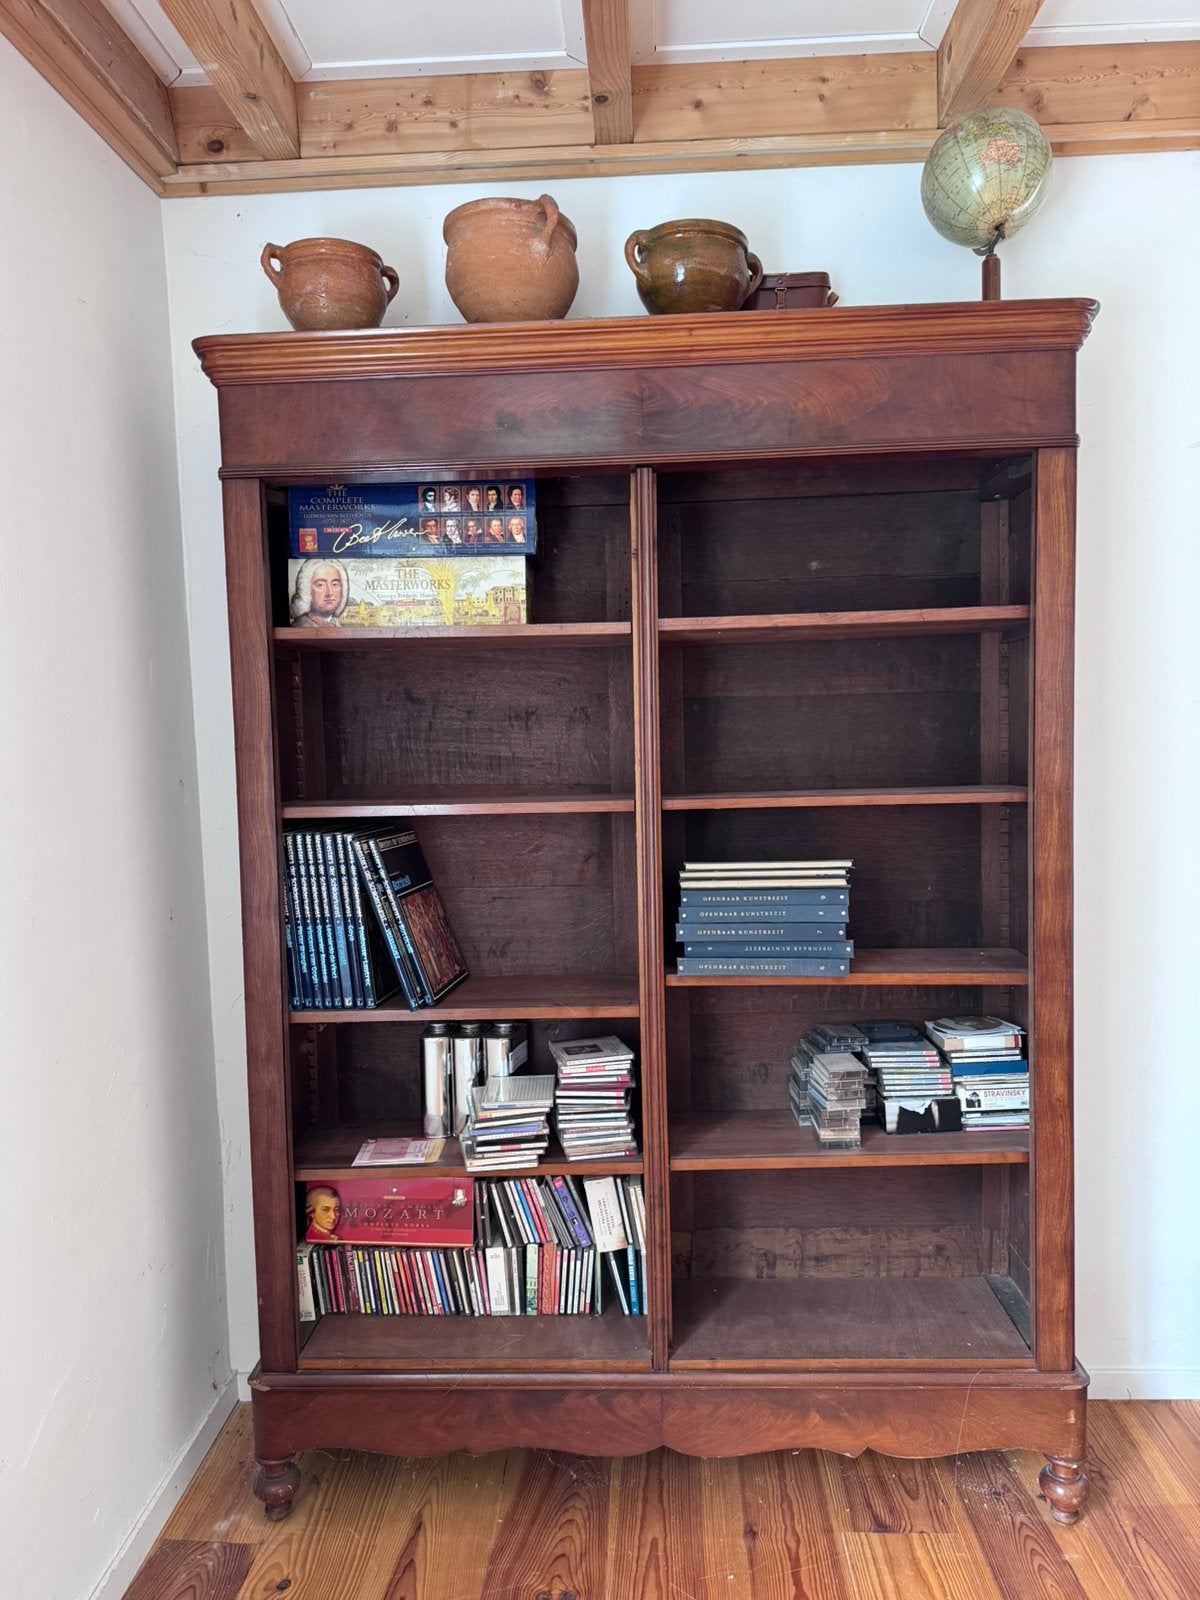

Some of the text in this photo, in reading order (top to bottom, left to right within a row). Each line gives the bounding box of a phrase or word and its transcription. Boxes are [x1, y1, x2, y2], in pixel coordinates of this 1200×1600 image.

[364, 580, 451, 590] MASTERWORKS
[396, 568, 420, 579] THE
[286, 836, 294, 864] Meesters
[292, 878, 301, 918] Schilderkunst
[296, 835, 304, 864] Meesters
[301, 877, 310, 918] Schilderkunst
[306, 834, 314, 864] Meesters
[311, 877, 320, 918] Schilderkunst
[315, 834, 323, 864] Meesters
[320, 876, 330, 918] Schilderkunst
[326, 924, 334, 954] Leonardo
[330, 954, 335, 962] da
[326, 836, 334, 864] Meesters
[330, 878, 340, 918] Schilderkunst
[336, 926, 346, 966] Rembrandt
[336, 834, 344, 864] Meesters
[342, 876, 352, 918] Schilderkunst
[352, 877, 362, 918] Schilderkunst
[355, 841, 369, 870] Meesters
[365, 870, 373, 882] der
[370, 882, 388, 922] Schilderkunst
[368, 840, 382, 870] Meesters
[384, 880, 401, 920] Schilderkunst
[345, 1208, 444, 1220] MOZART
[346, 1252, 355, 1272] BACH
